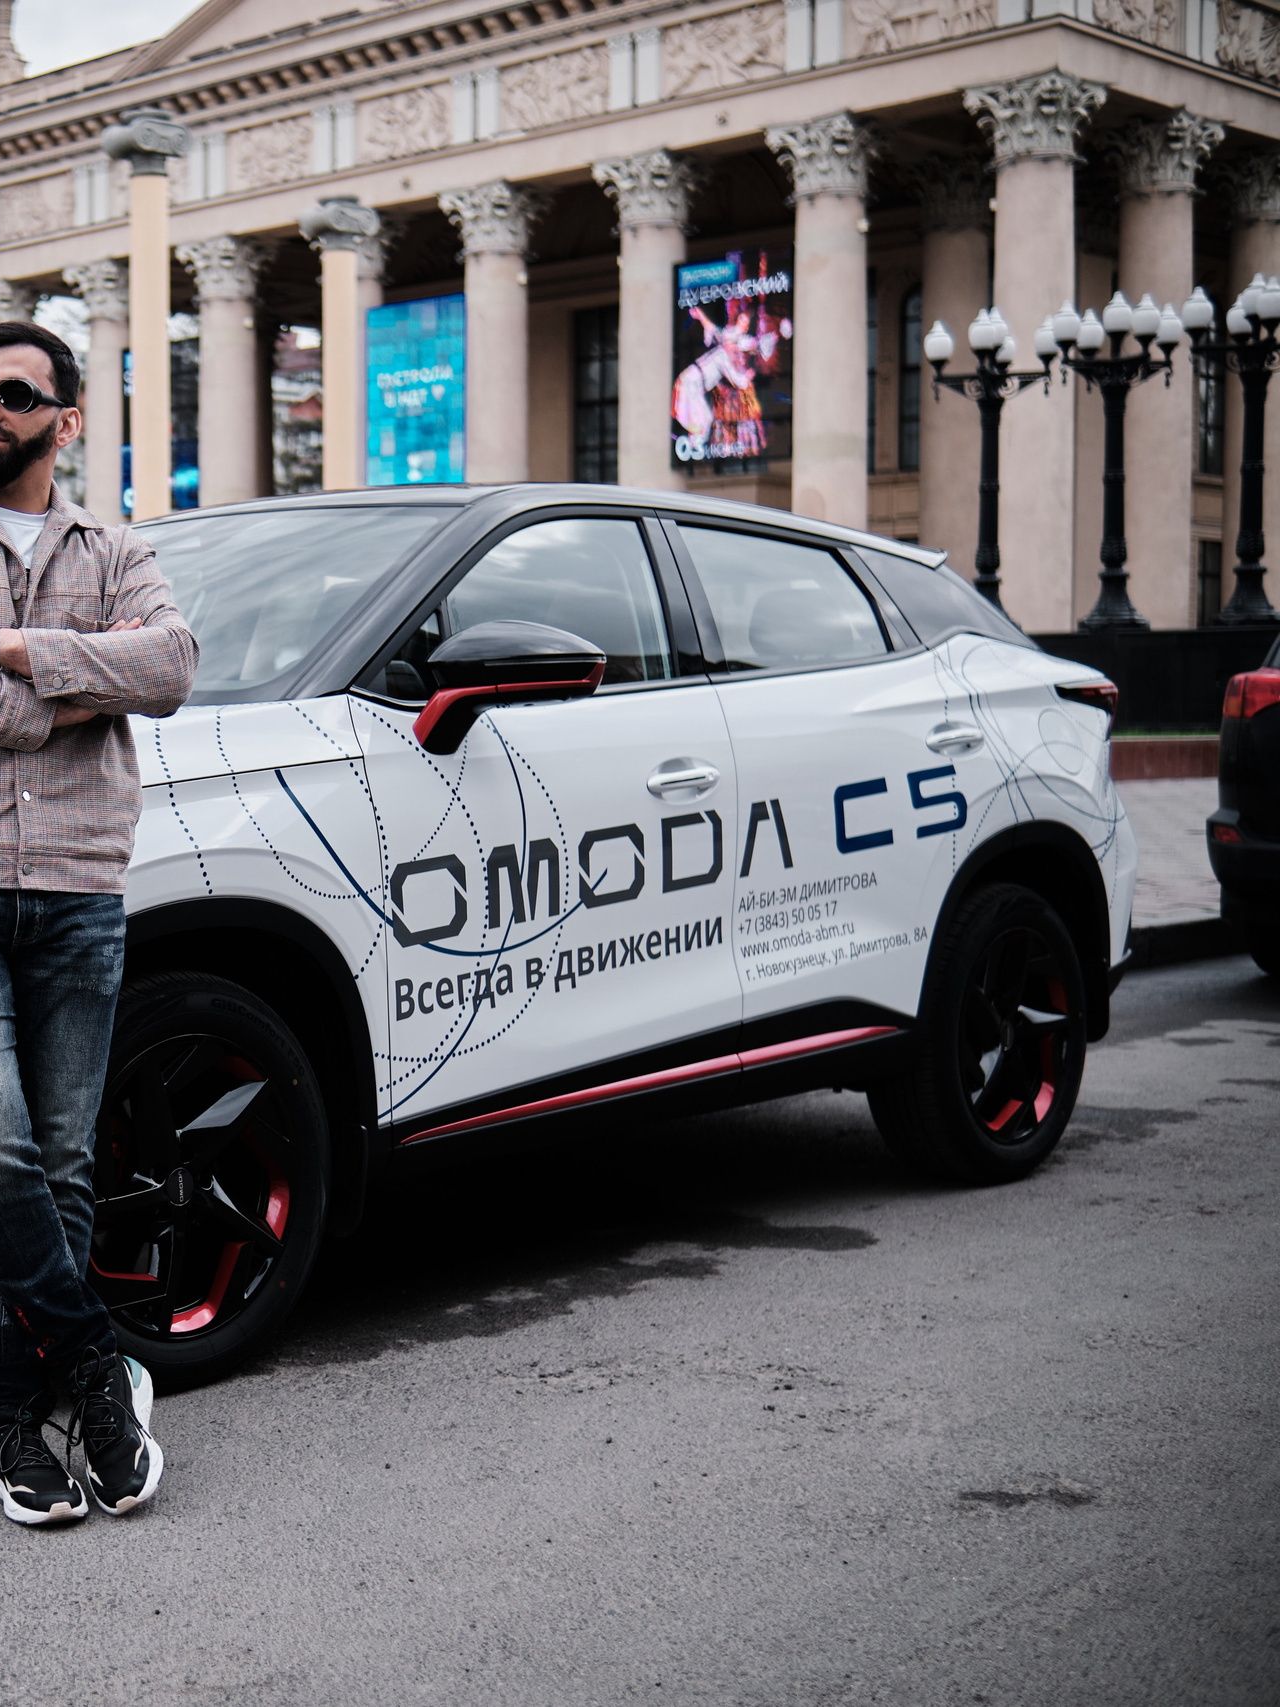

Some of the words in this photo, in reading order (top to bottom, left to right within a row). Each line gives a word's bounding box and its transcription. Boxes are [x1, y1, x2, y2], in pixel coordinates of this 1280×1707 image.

[390, 798, 793, 948] OMODA
[833, 764, 968, 855] C5
[738, 886, 797, 914] АЙ-БИ-ЭМ
[799, 872, 878, 902] ДИМИТРОВА
[738, 919, 752, 936] +7
[754, 909, 789, 936] (3843)
[792, 907, 805, 925] 50
[808, 905, 821, 921] 05
[825, 901, 838, 917] 17
[740, 921, 855, 959] www.omoda-abm.ru
[746, 967, 756, 982] г.
[757, 952, 831, 979] Новокузнецк,
[832, 948, 848, 966] ул.
[849, 931, 911, 960] Димитрова,
[914, 926, 928, 942] 8А
[395, 962, 515, 1021] Всегда
[525, 957, 544, 988] в
[554, 916, 724, 993] движении
[212, 998, 286, 1050] GitiComfort
